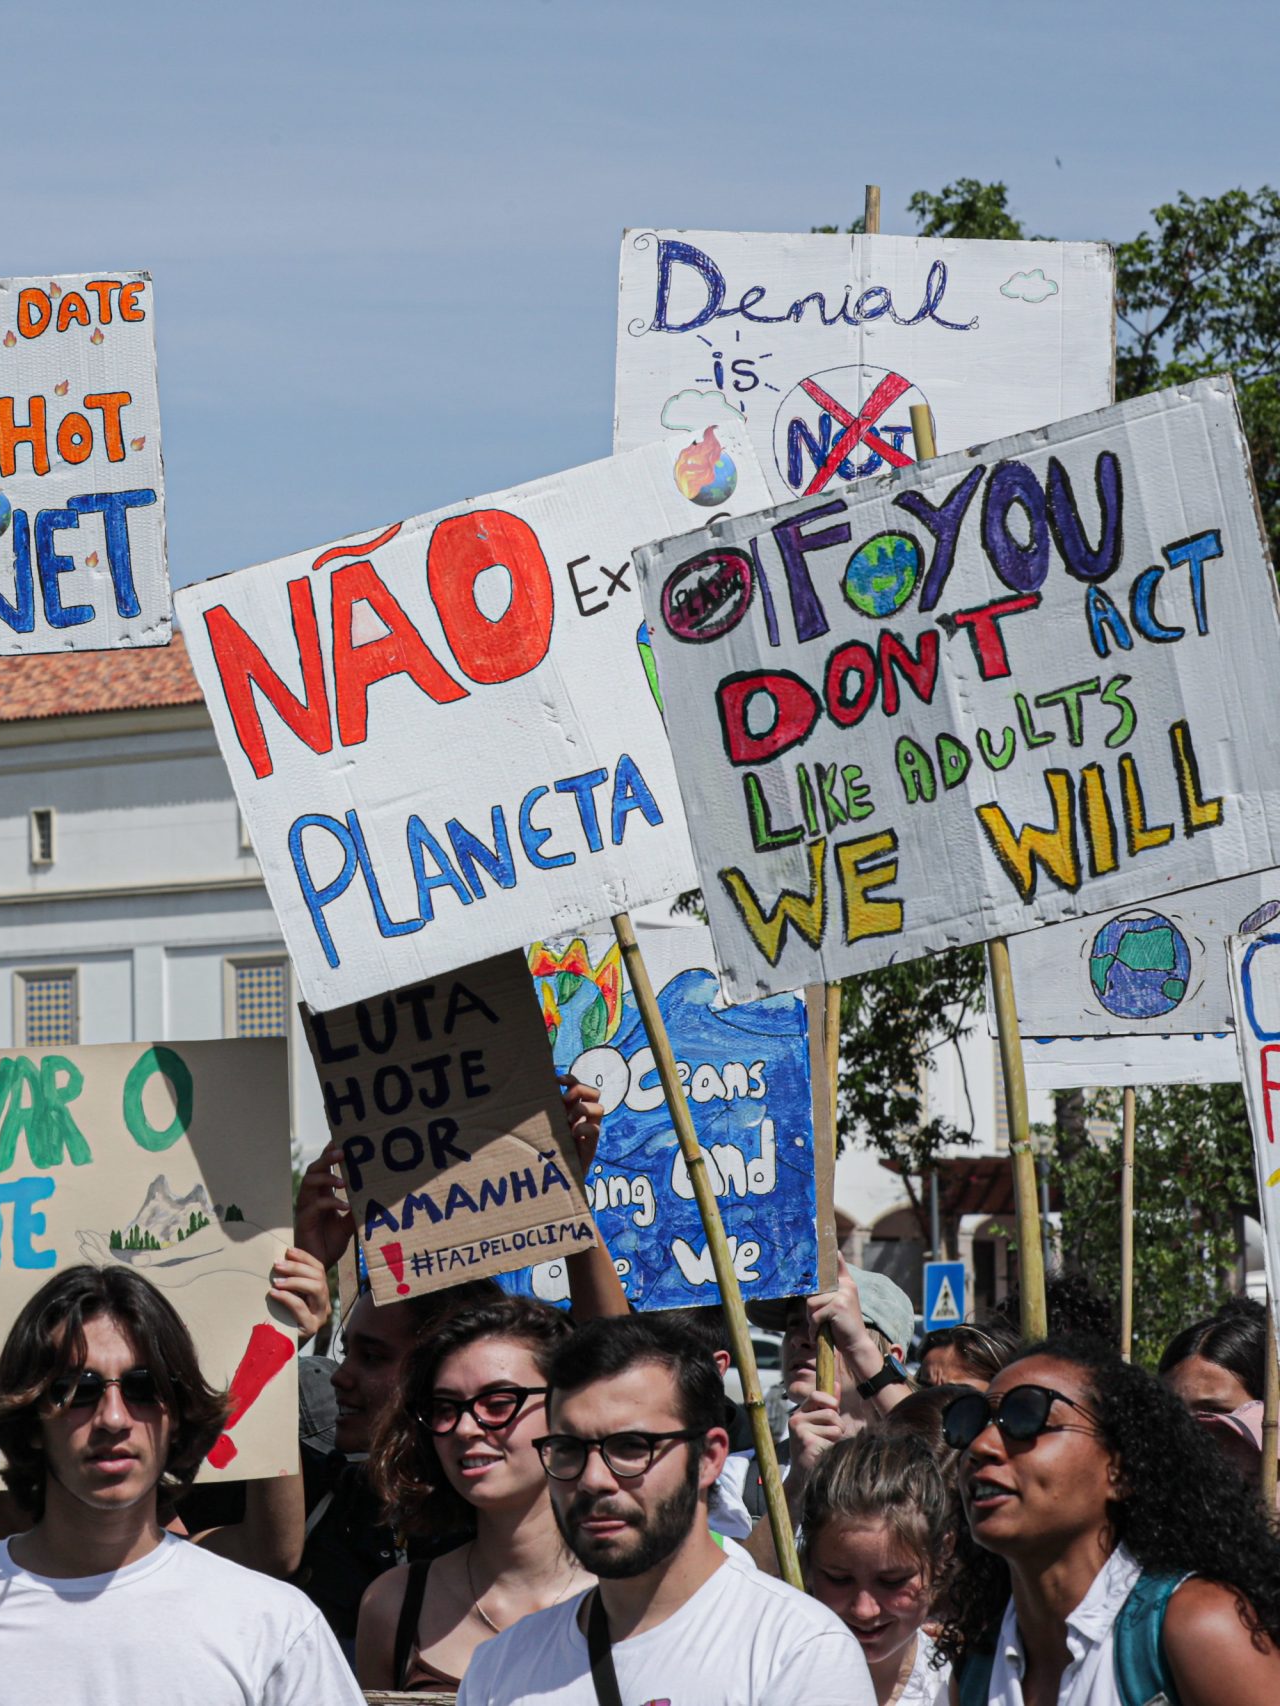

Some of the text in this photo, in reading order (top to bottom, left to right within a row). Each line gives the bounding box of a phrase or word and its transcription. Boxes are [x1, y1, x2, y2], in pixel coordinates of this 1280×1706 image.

[17, 280, 146, 339] DATE
[629, 233, 979, 337] Denial
[712, 351, 760, 393] is
[787, 411, 912, 489] NOT
[750, 451, 1123, 647] IF YOU
[1085, 530, 1223, 658] ACT
[203, 509, 554, 779] NÃO
[742, 675, 1138, 853] LIKE ADULTS
[288, 753, 663, 968] PLANETA
[719, 720, 1223, 968] WE WILL
[310, 981, 500, 1064] LUTA
[123, 1046, 194, 1152] O
[324, 1050, 491, 1126] HOJE
[341, 1117, 471, 1192] POR
[365, 1150, 571, 1241] AMANHÃ
[671, 1119, 776, 1199] and
[410, 1222, 594, 1277] #FAZPELOCLIMA
